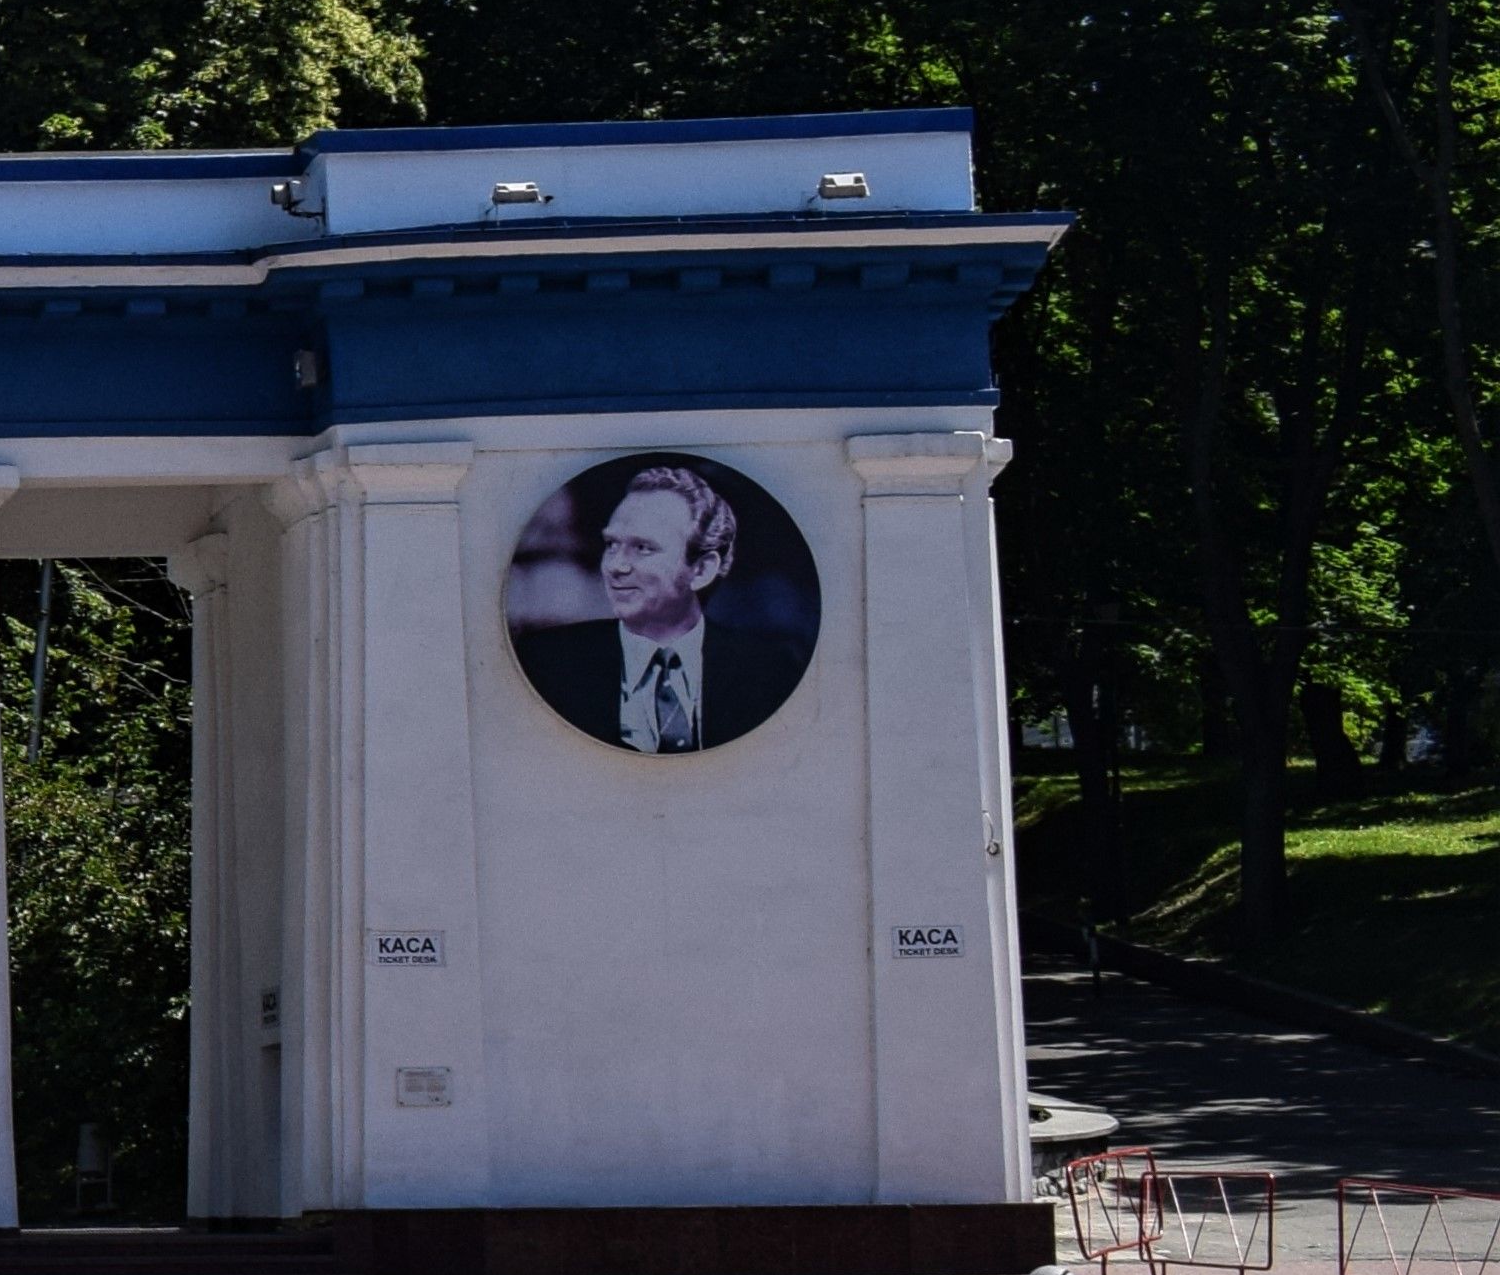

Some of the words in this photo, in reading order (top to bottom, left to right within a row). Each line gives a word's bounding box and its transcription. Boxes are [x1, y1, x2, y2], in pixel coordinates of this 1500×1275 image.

[898, 928, 959, 946] КАСА
[378, 937, 436, 954] КАСА
[898, 948, 931, 956] TICKET
[379, 956, 410, 964] TICKET
